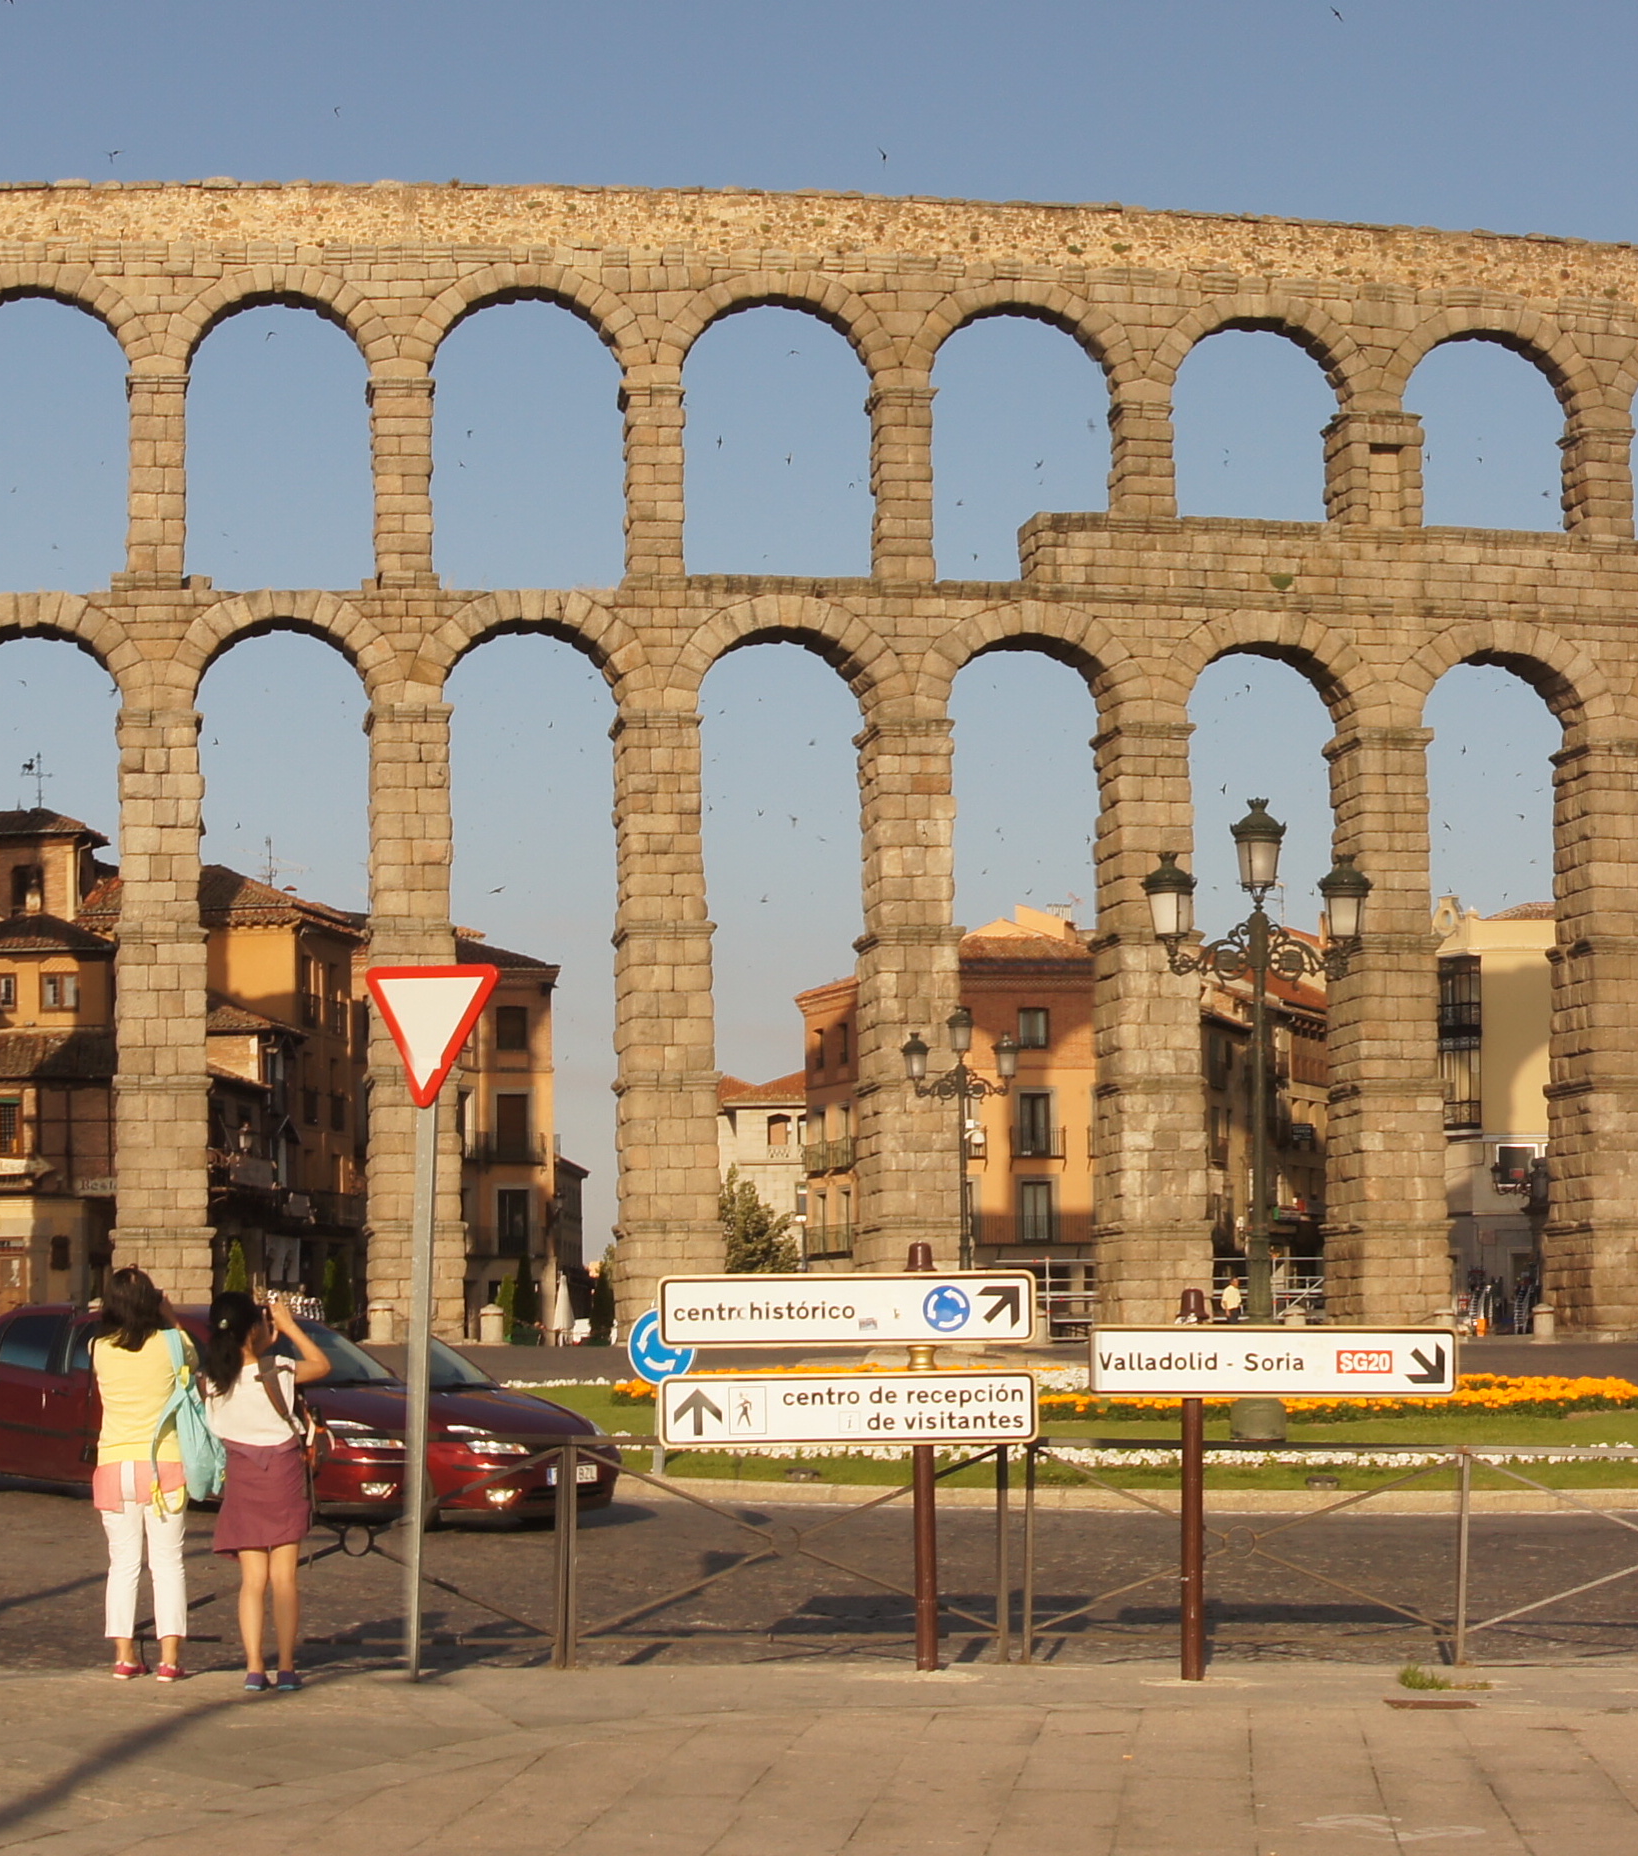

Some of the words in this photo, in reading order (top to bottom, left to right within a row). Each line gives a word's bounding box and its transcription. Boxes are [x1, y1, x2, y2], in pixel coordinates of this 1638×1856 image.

[674, 1301, 748, 1321] centro
[750, 1298, 855, 1321] histórico
[1099, 1351, 1219, 1371] Valladolid
[1244, 1352, 1305, 1372] Soria
[1339, 1352, 1391, 1374] SG20
[783, 1388, 860, 1405] centro
[869, 1386, 895, 1404] de
[907, 1383, 1025, 1408] recepción
[867, 1412, 895, 1431] de
[905, 1410, 1025, 1430] visitantes
